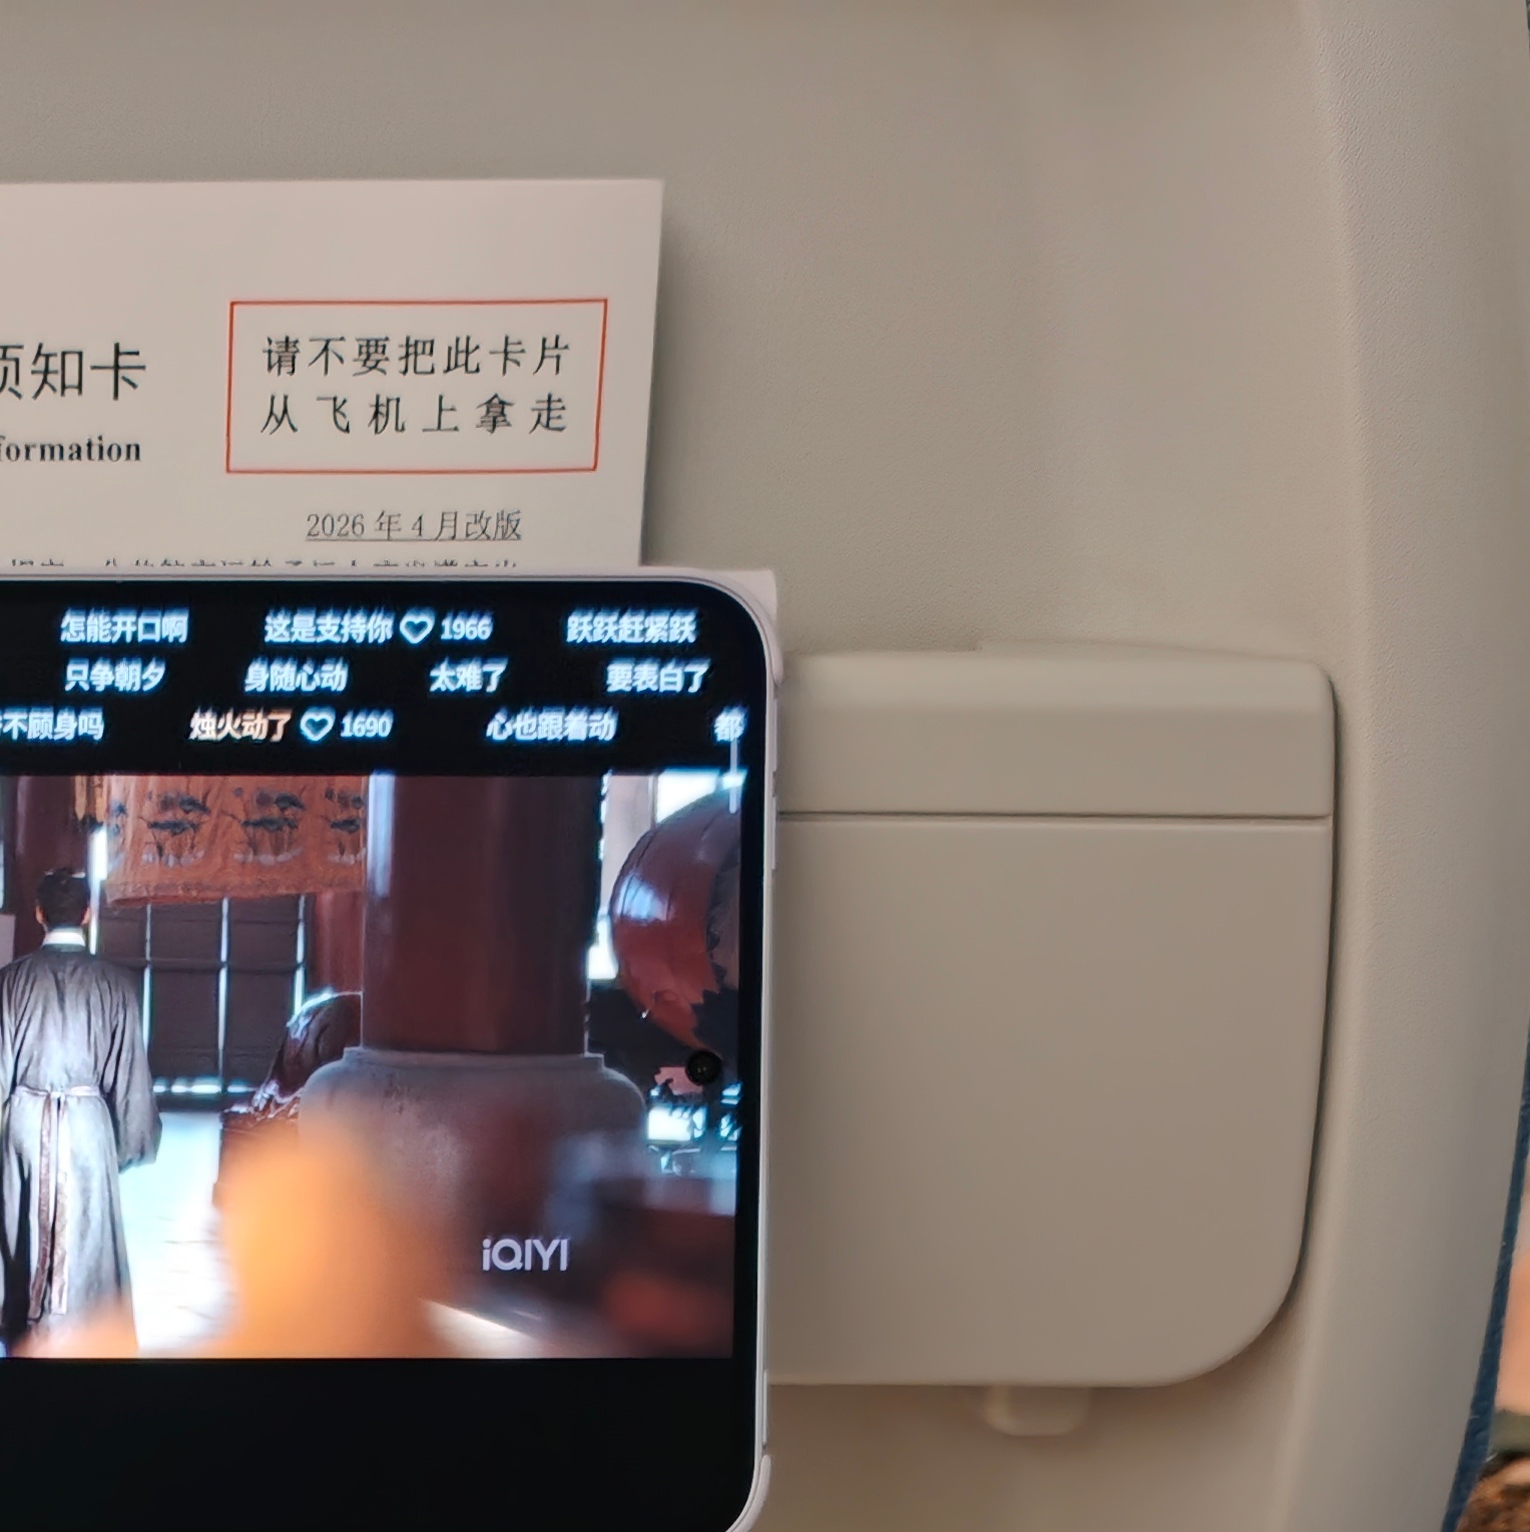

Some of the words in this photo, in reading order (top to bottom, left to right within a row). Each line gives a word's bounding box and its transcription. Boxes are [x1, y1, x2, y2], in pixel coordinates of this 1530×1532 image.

[261, 334, 571, 378] 请不要把此卡片
[259, 392, 568, 436] 从飞机上拿走
[60, 607, 190, 643] 怎能开口啊
[264, 607, 393, 643] 这是支持你
[440, 611, 493, 641] 1966
[64, 657, 166, 692] 只争朝夕
[244, 656, 349, 692] 身随心动
[428, 656, 509, 692] 太难了
[605, 657, 710, 693] 要表白了
[340, 710, 393, 738] 1690
[485, 706, 620, 742] 心也跟着动
[481, 1237, 570, 1272] iQIYI
